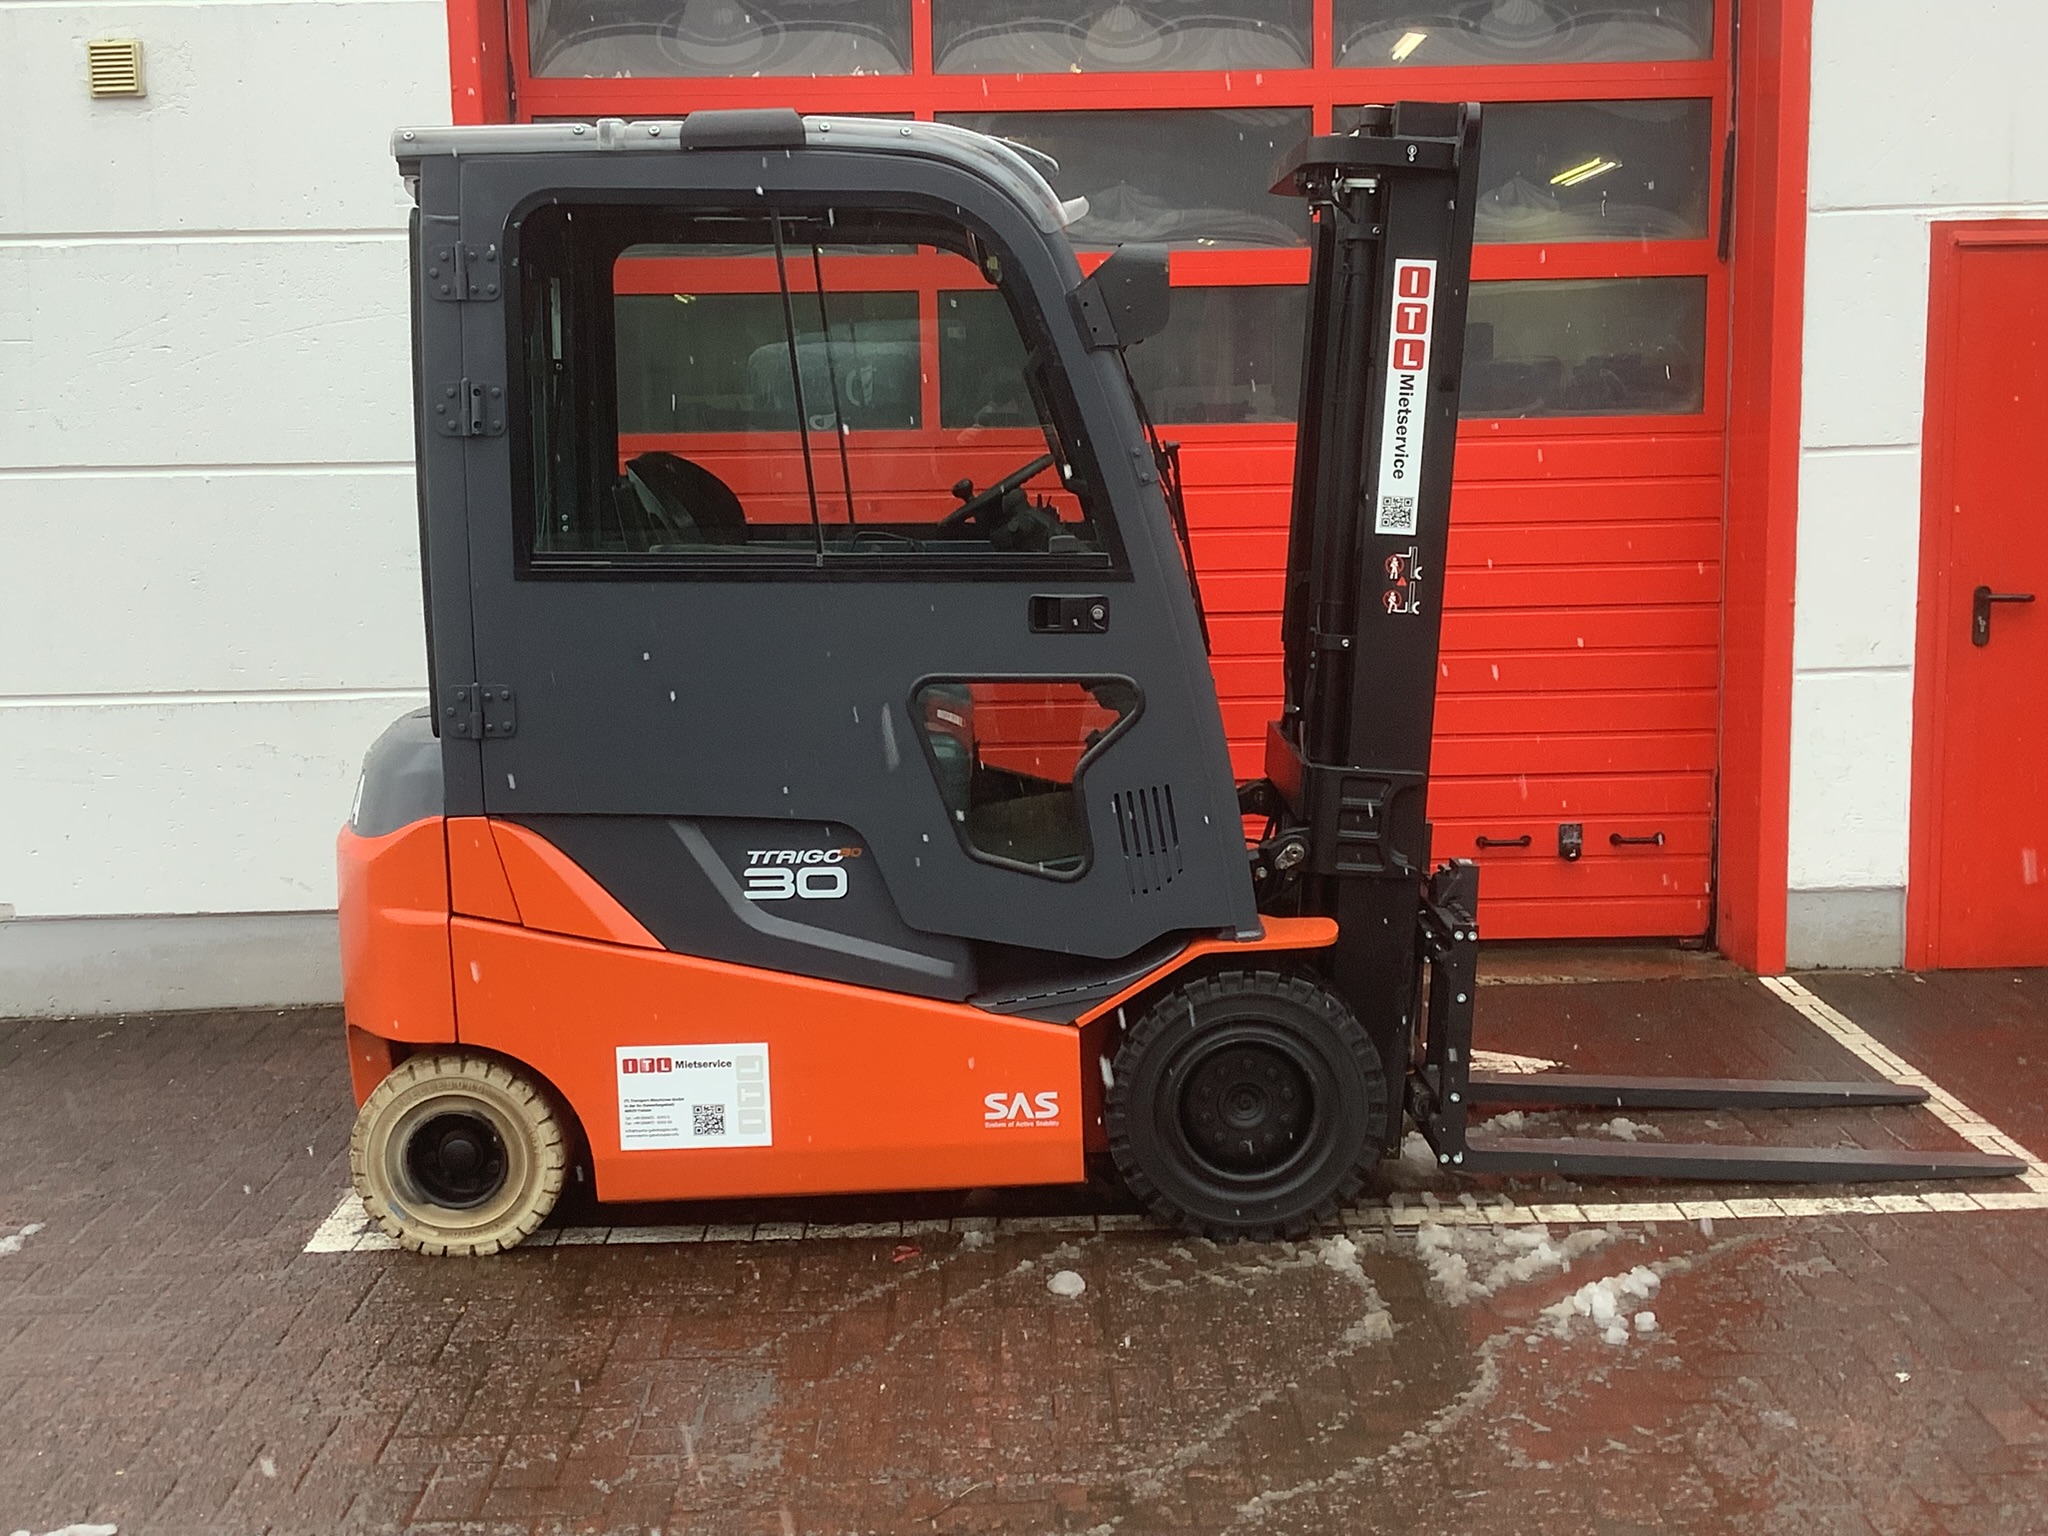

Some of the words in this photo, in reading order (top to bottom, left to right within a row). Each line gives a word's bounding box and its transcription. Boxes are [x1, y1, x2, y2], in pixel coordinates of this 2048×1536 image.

[1399, 268, 1421, 368] ITL
[1392, 374, 1415, 480] Mietservice
[747, 850, 844, 865] TRAIGO
[743, 867, 848, 899] 30
[626, 1058, 671, 1073] ITL
[675, 1059, 732, 1069] Mietservice
[984, 1091, 1059, 1120] SAS
